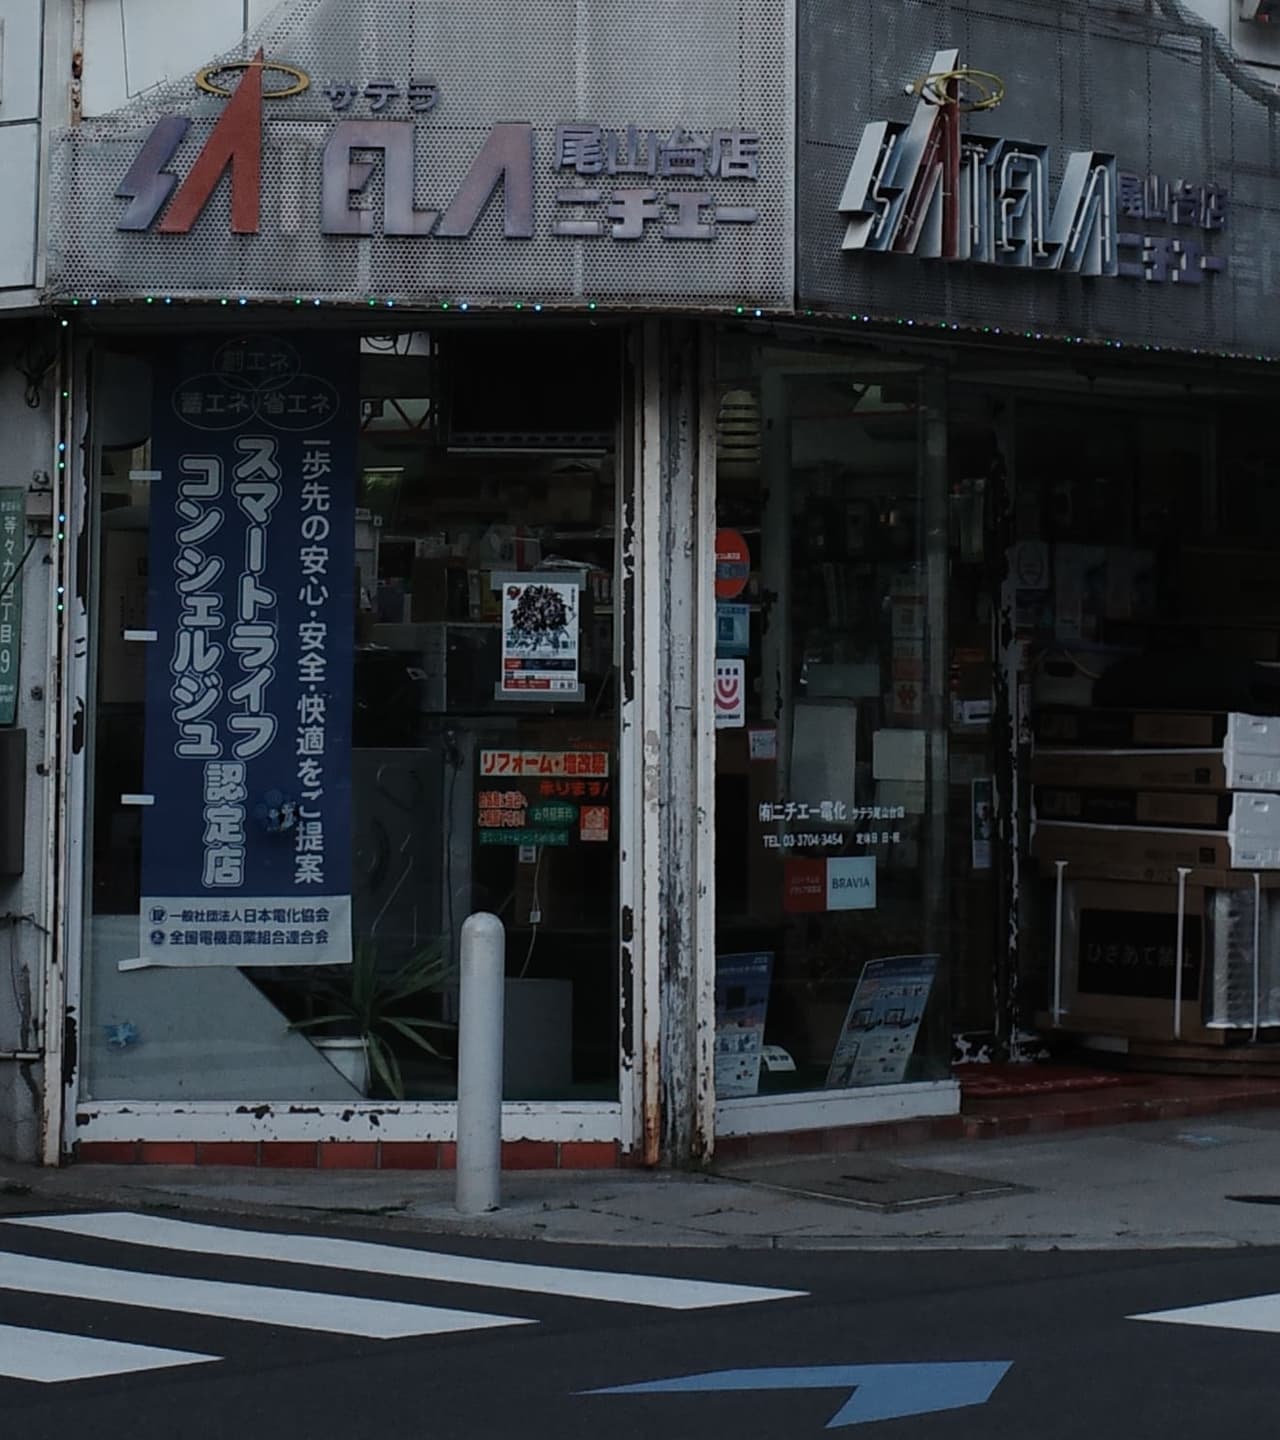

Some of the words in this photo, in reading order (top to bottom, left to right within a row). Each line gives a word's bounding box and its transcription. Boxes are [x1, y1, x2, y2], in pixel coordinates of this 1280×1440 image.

[322, 77, 440, 112] サテラ
[552, 122, 760, 180] 尾山台店
[552, 187, 760, 240] ニチエー
[227, 435, 283, 760] スマートライフ
[201, 759, 248, 888] 認定店
[762, 834, 782, 849] TEL
[832, 876, 871, 890] BRAVIA
